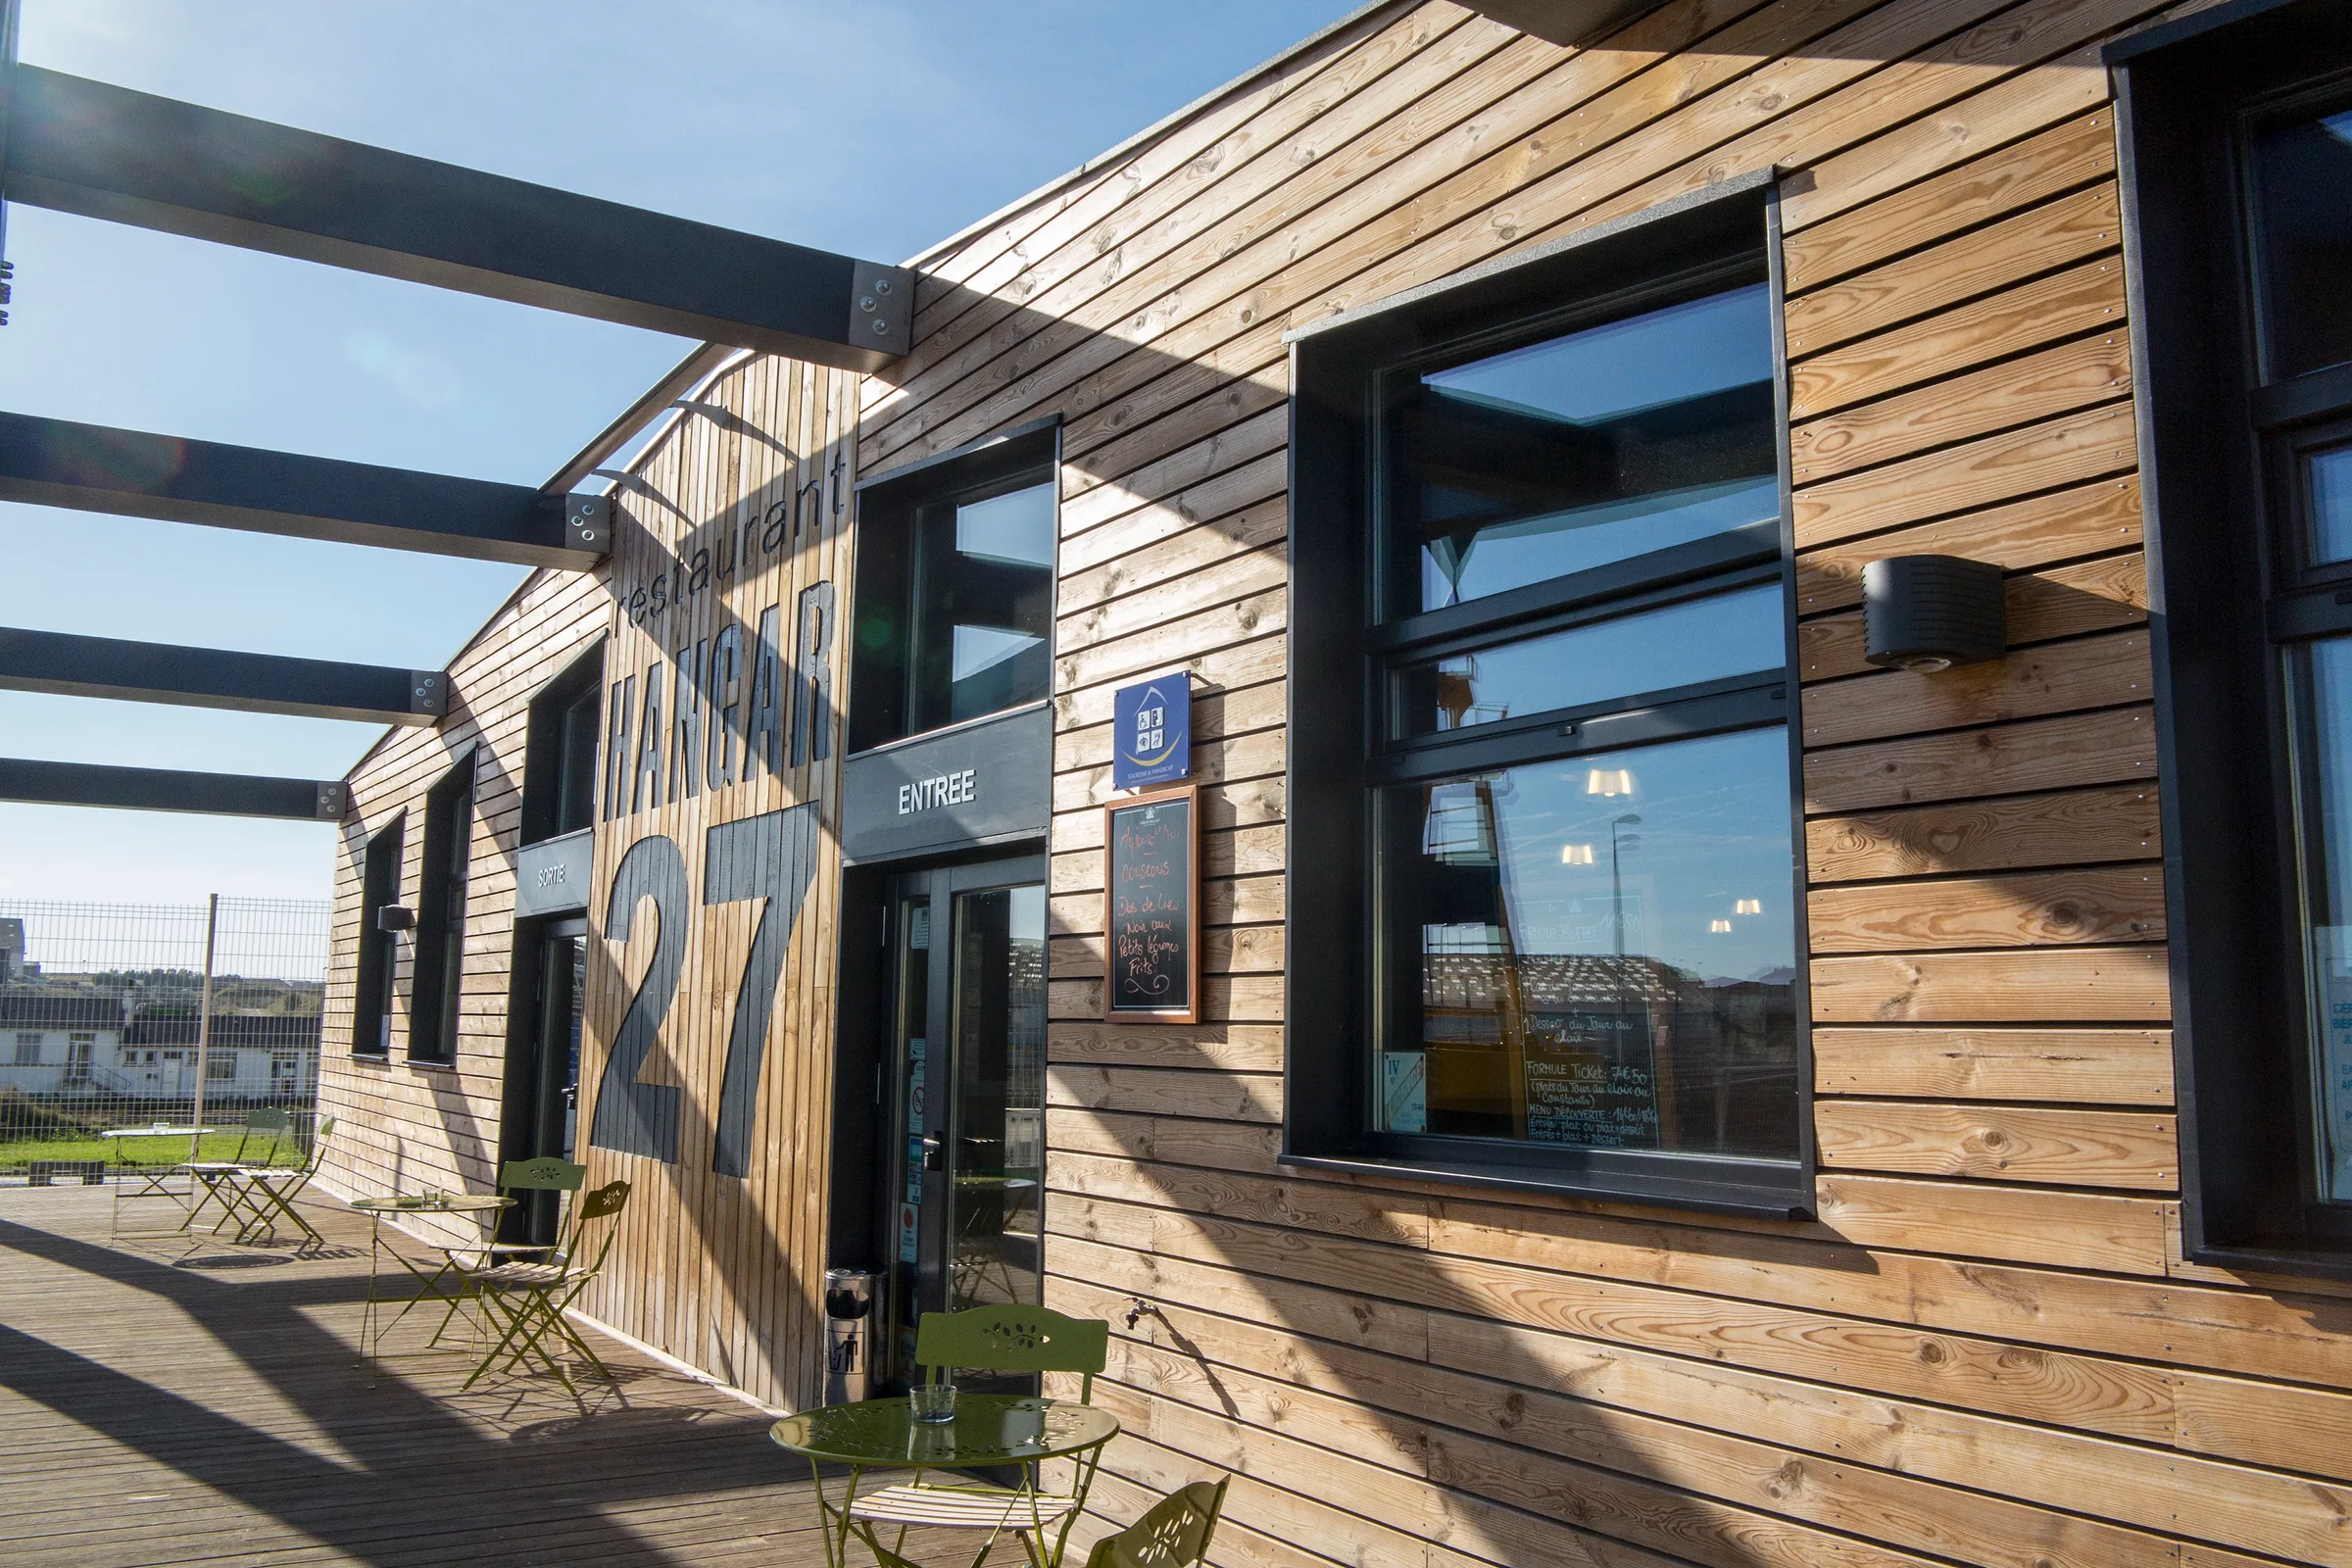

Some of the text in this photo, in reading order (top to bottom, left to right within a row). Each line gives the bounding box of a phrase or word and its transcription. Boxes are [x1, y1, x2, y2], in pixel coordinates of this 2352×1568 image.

[614, 450, 846, 639] restaurant
[603, 580, 835, 823] HANGAR
[899, 769, 975, 815] ENTREE
[538, 864, 565, 888] SORTIE
[1142, 897, 1155, 912] de
[1119, 935, 1179, 964] Petits légumes
[590, 800, 819, 1179] 27
[1569, 1019, 1585, 1030] du
[1388, 1060, 1399, 1074] IV
[1529, 1103, 1551, 1115] MENU
